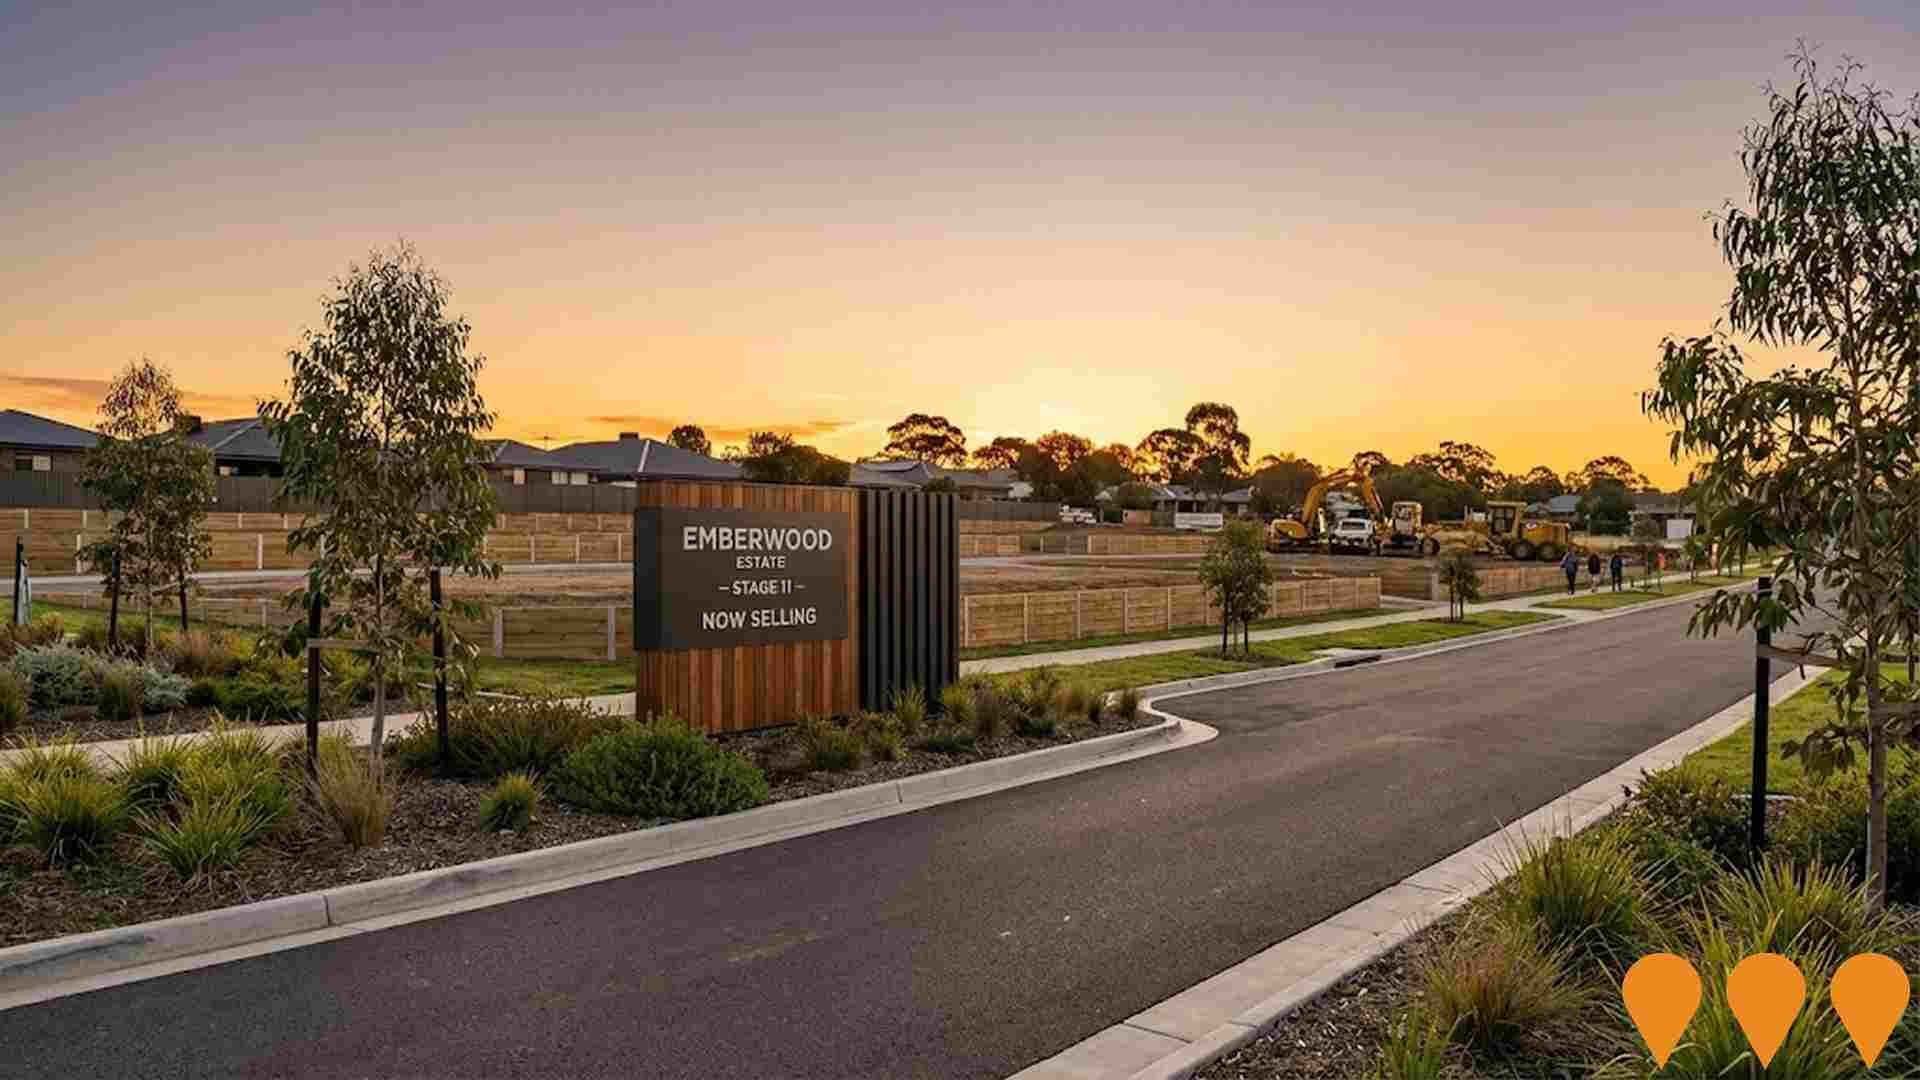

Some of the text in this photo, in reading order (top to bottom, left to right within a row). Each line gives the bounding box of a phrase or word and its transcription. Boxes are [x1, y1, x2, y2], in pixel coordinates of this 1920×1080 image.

[683, 526, 832, 550] EMBERWOOD
[736, 555, 785, 569] ESTATE
[732, 580, 778, 596] STAGE
[702, 607, 817, 630] NOW SELLING
